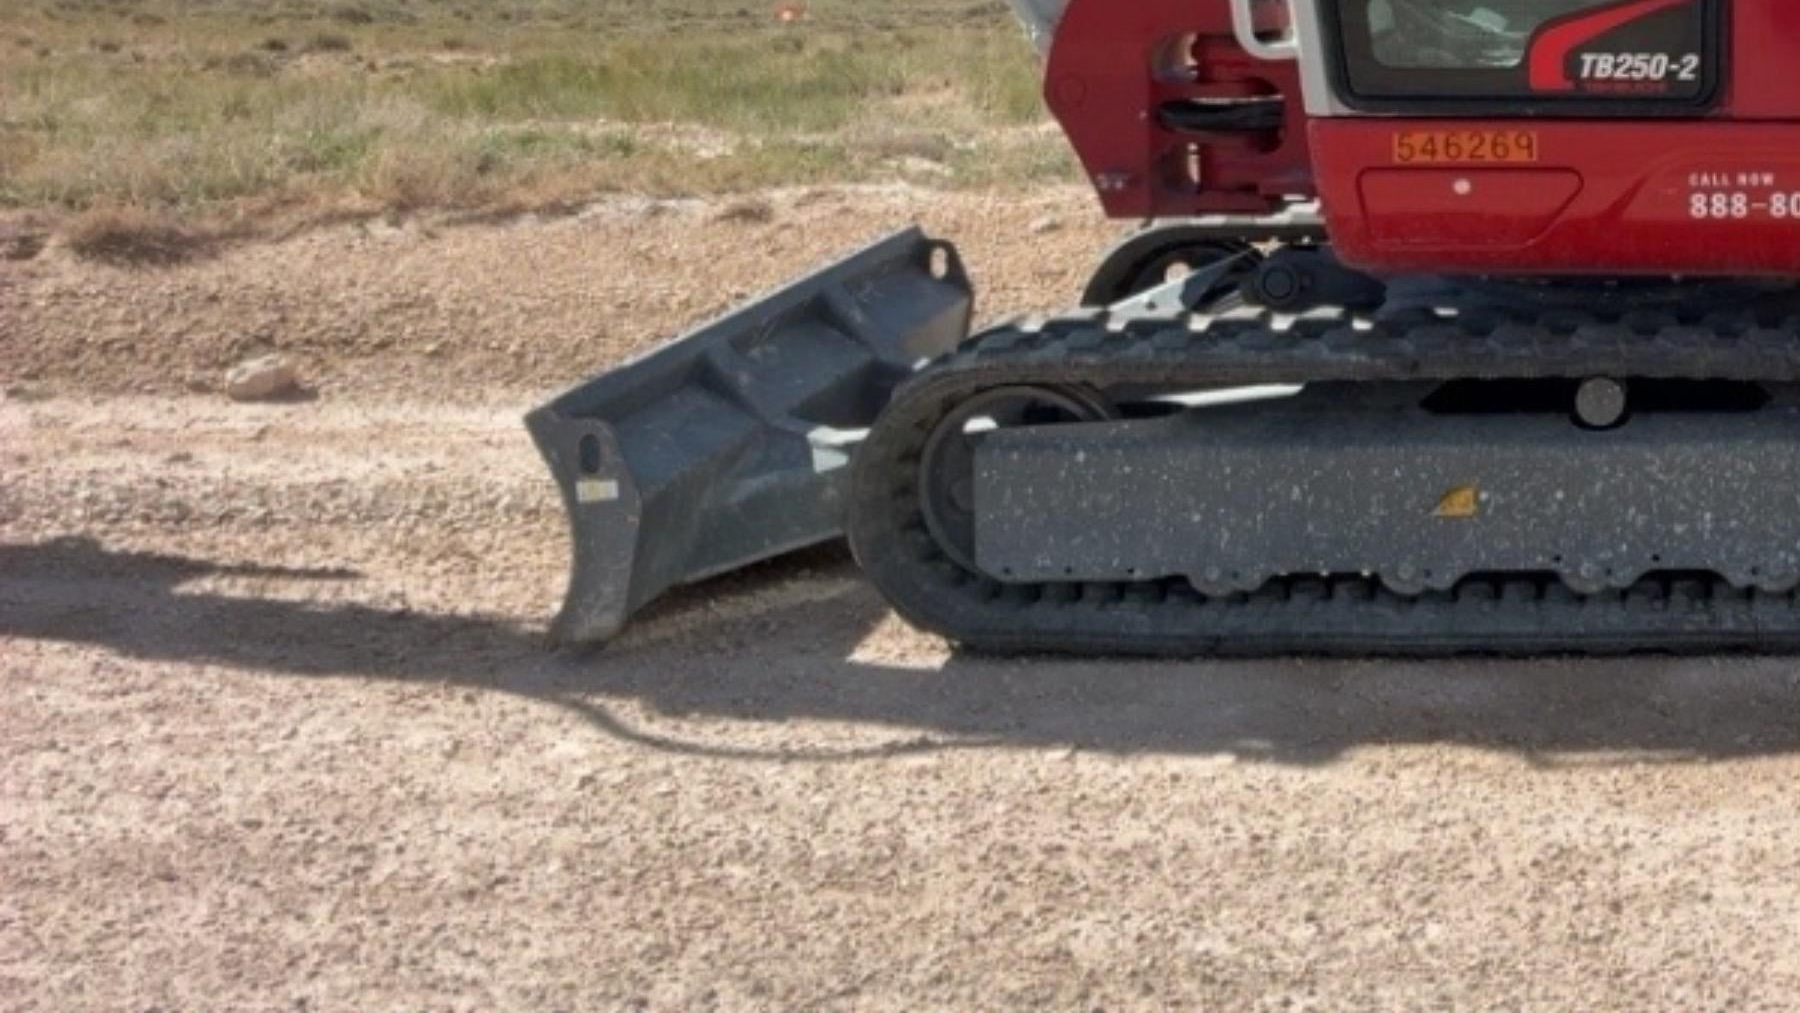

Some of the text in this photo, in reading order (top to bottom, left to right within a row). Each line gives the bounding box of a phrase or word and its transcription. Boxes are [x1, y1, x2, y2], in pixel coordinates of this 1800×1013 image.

[1579, 51, 1700, 81] TB250-2
[1397, 130, 1535, 162] 546269
[1689, 171, 1775, 187] CALL NOW
